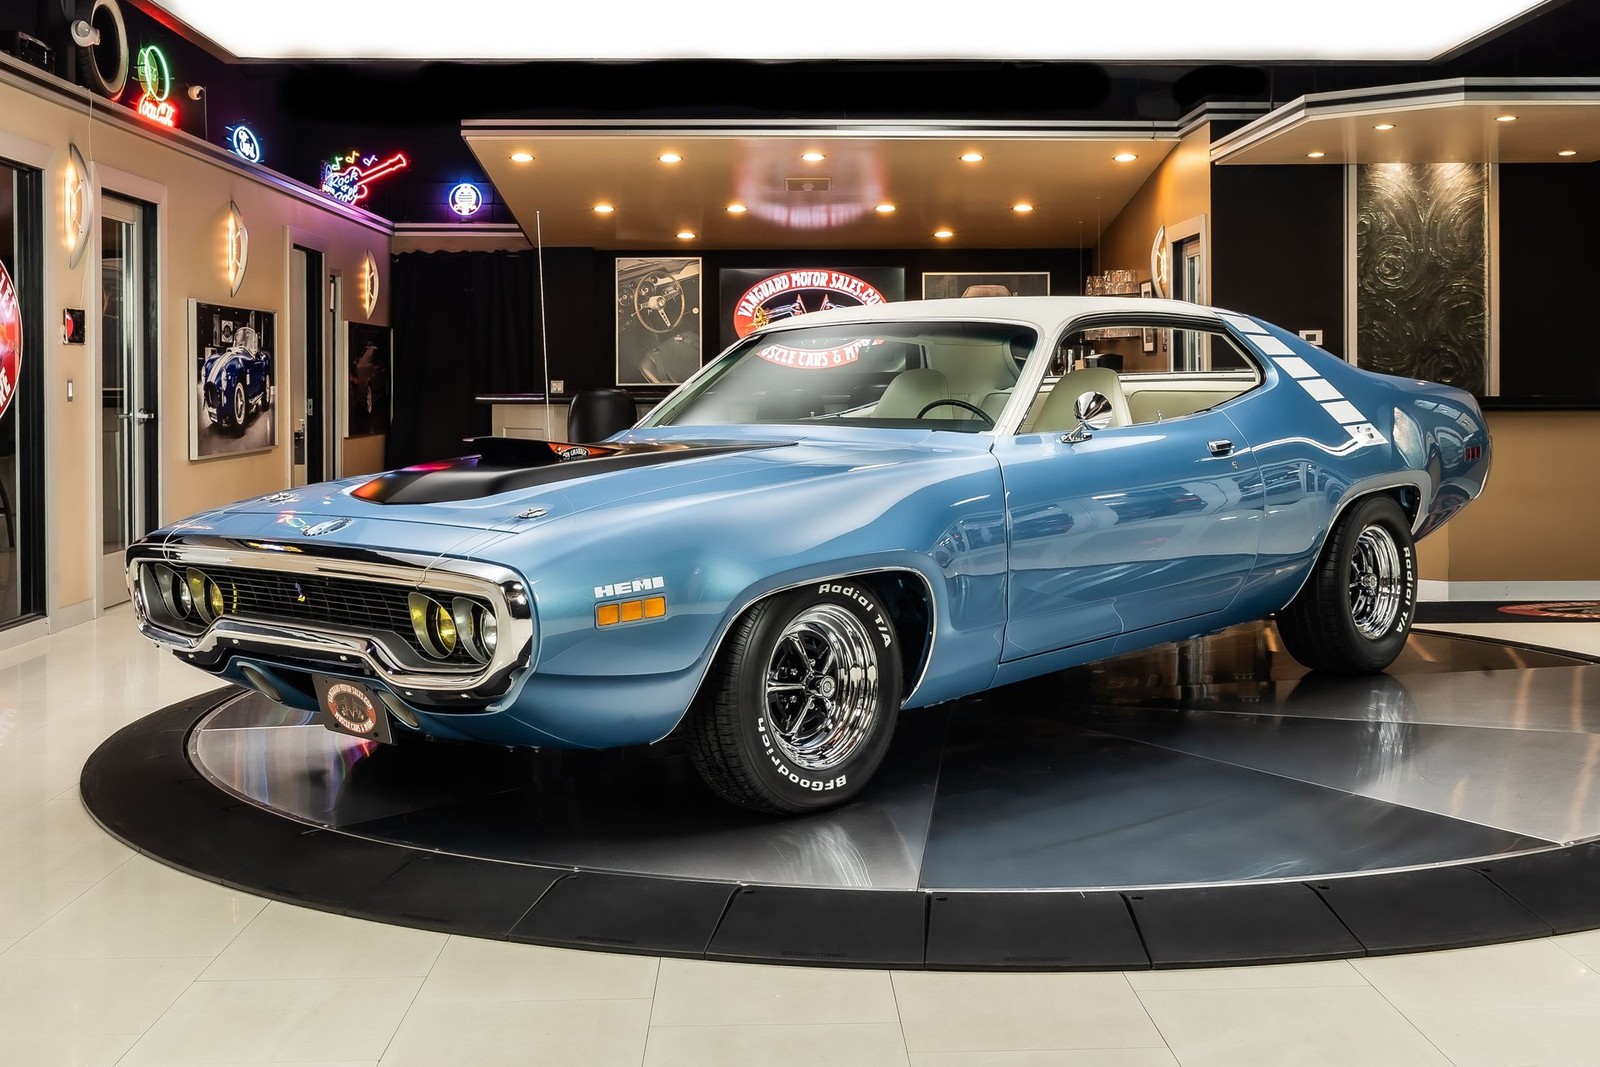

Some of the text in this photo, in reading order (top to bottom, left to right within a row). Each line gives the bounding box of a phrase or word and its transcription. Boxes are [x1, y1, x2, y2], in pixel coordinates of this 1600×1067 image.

[331, 168, 358, 188] Rock
[738, 271, 883, 317] VANGUARD MOTOR SALES.CO
[761, 345, 798, 365] USCLE
[798, 350, 828, 367] CARS
[832, 350, 842, 364] &
[594, 576, 664, 598] HEMI
[1396, 546, 1413, 633] Radial T/A
[818, 583, 892, 648] Radial T/A
[757, 717, 847, 791] BFGoodrich
